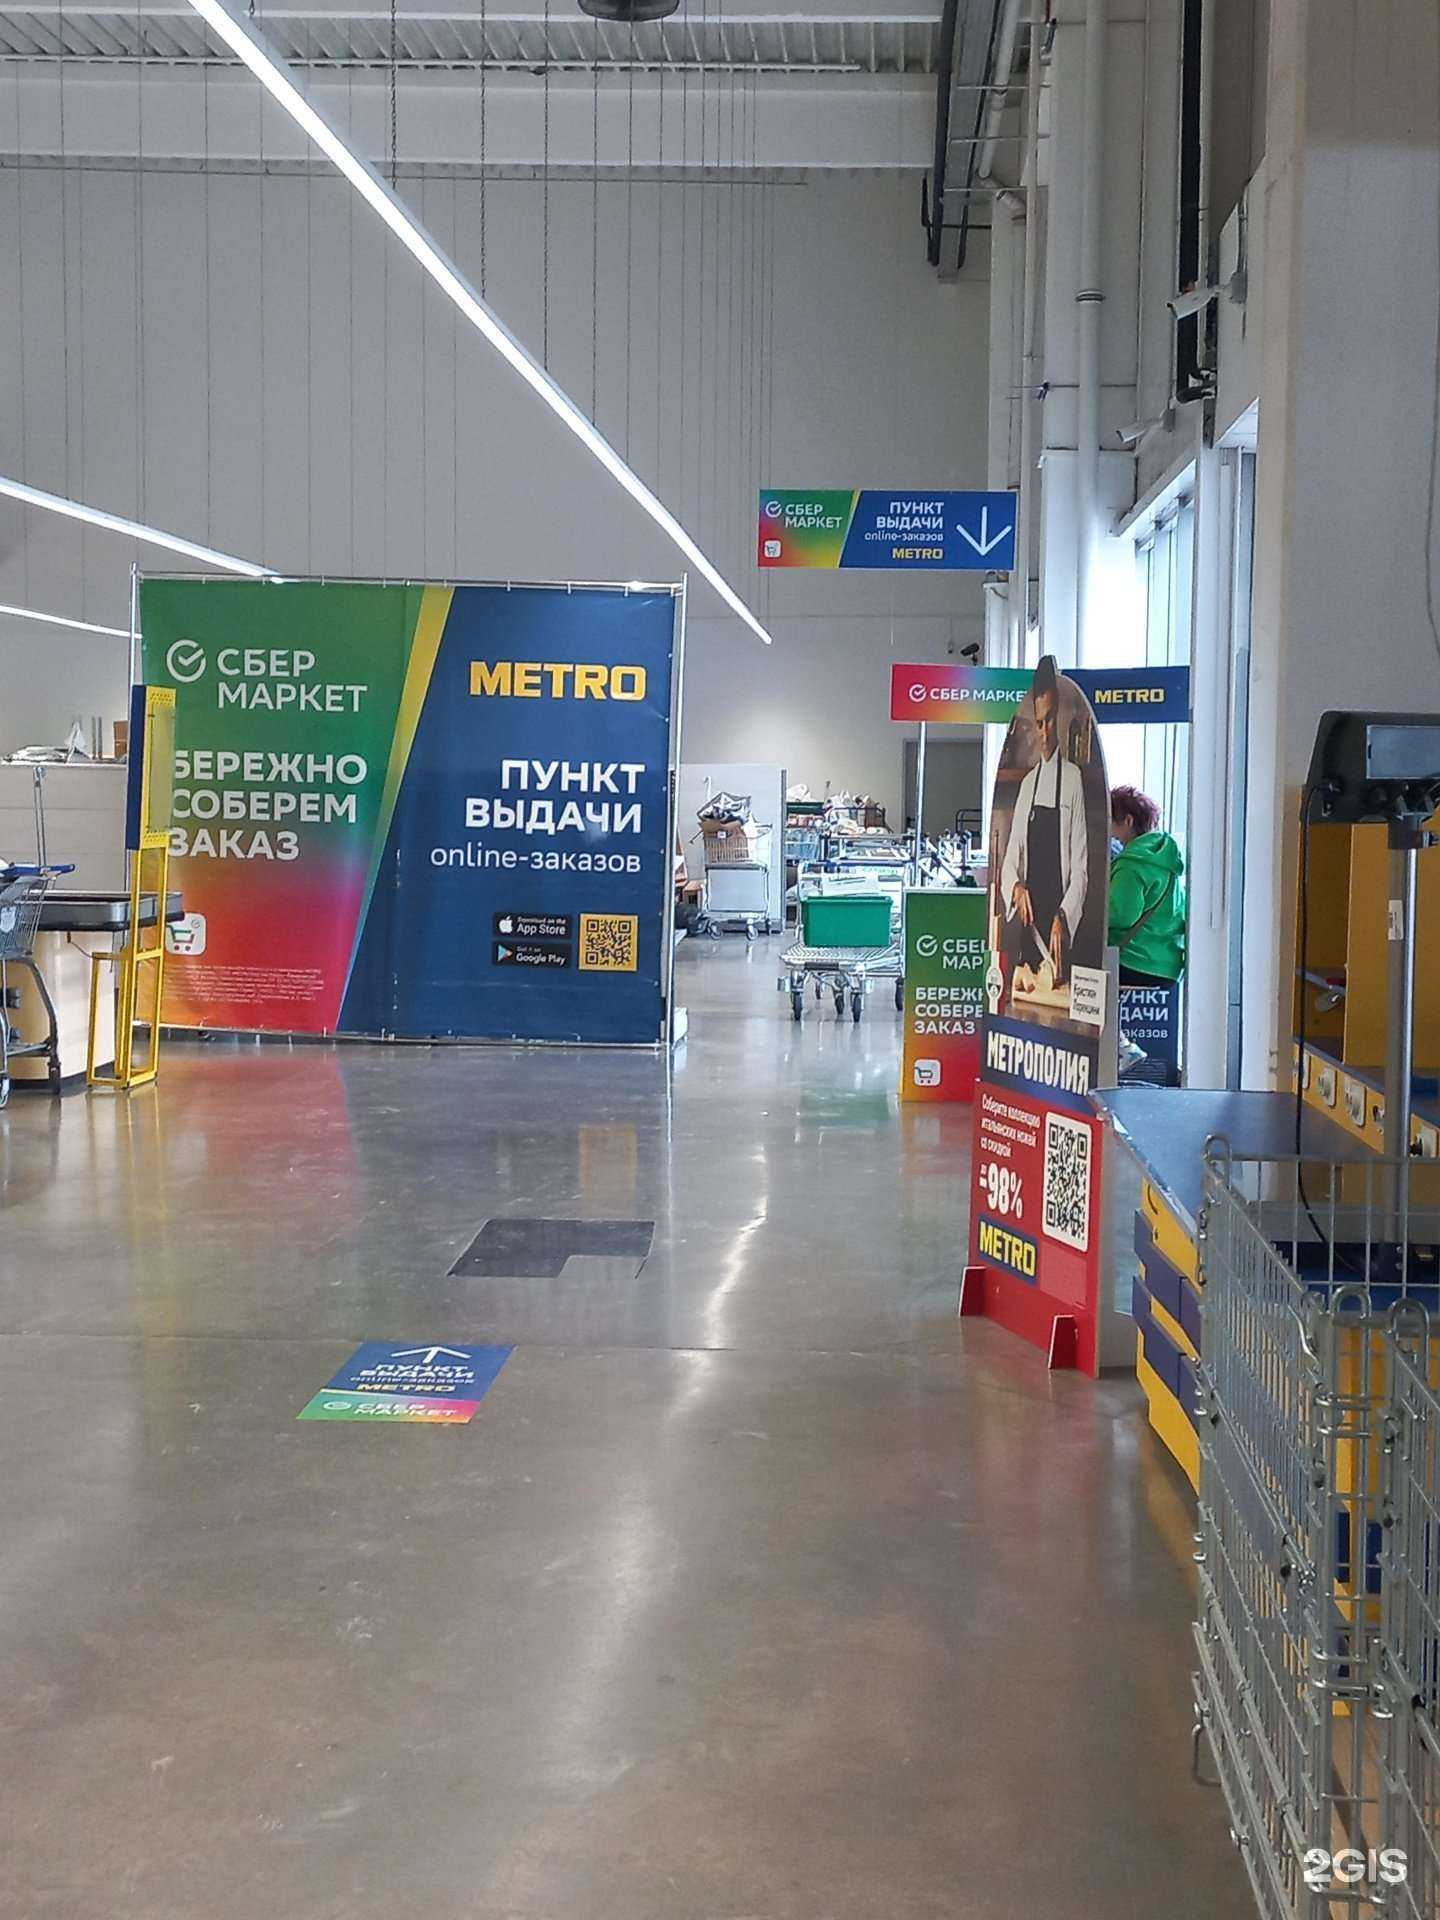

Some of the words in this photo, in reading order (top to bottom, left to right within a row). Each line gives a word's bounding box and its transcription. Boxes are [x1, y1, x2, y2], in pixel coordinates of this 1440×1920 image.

[785, 503, 823, 516] СБЕР
[889, 501, 944, 515] ПУНКТ
[784, 516, 842, 529] МАРКЕТ
[876, 516, 944, 530] ВЫДАЧИ
[892, 547, 943, 559] METRO
[217, 648, 316, 678] СБЕР
[470, 661, 646, 701] METRO
[218, 682, 368, 713] МАРКЕТ
[930, 687, 970, 700] СБЕР
[972, 689, 1027, 703] МАРКЕ
[1095, 688, 1165, 704] METRO
[174, 750, 367, 785] БЕРЕЖНО
[501, 759, 646, 794] ПУНКТ
[172, 788, 357, 824] СОБЕРЕМ
[465, 797, 642, 835] ВЫДАЧИ
[168, 827, 299, 861] ЗАКАЗ
[430, 841, 642, 873] online-заказов
[517, 923, 537, 936] App
[539, 924, 566, 935] Store
[516, 952, 547, 964] Google
[548, 954, 566, 966] Play
[915, 987, 983, 1001] БЕРЕЖ
[1120, 990, 1170, 1004] УНКТ
[914, 1004, 983, 1018] СОБЕРЕ
[1120, 1007, 1169, 1022] ДАЧИ
[914, 1020, 975, 1035] ЗАКАЗ
[987, 1031, 1090, 1096] МЕТРОПОЛИЯ
[979, 1221, 1036, 1277] METRO
[376, 1364, 468, 1372] ПУНКТ
[357, 1384, 457, 1392] METRO
